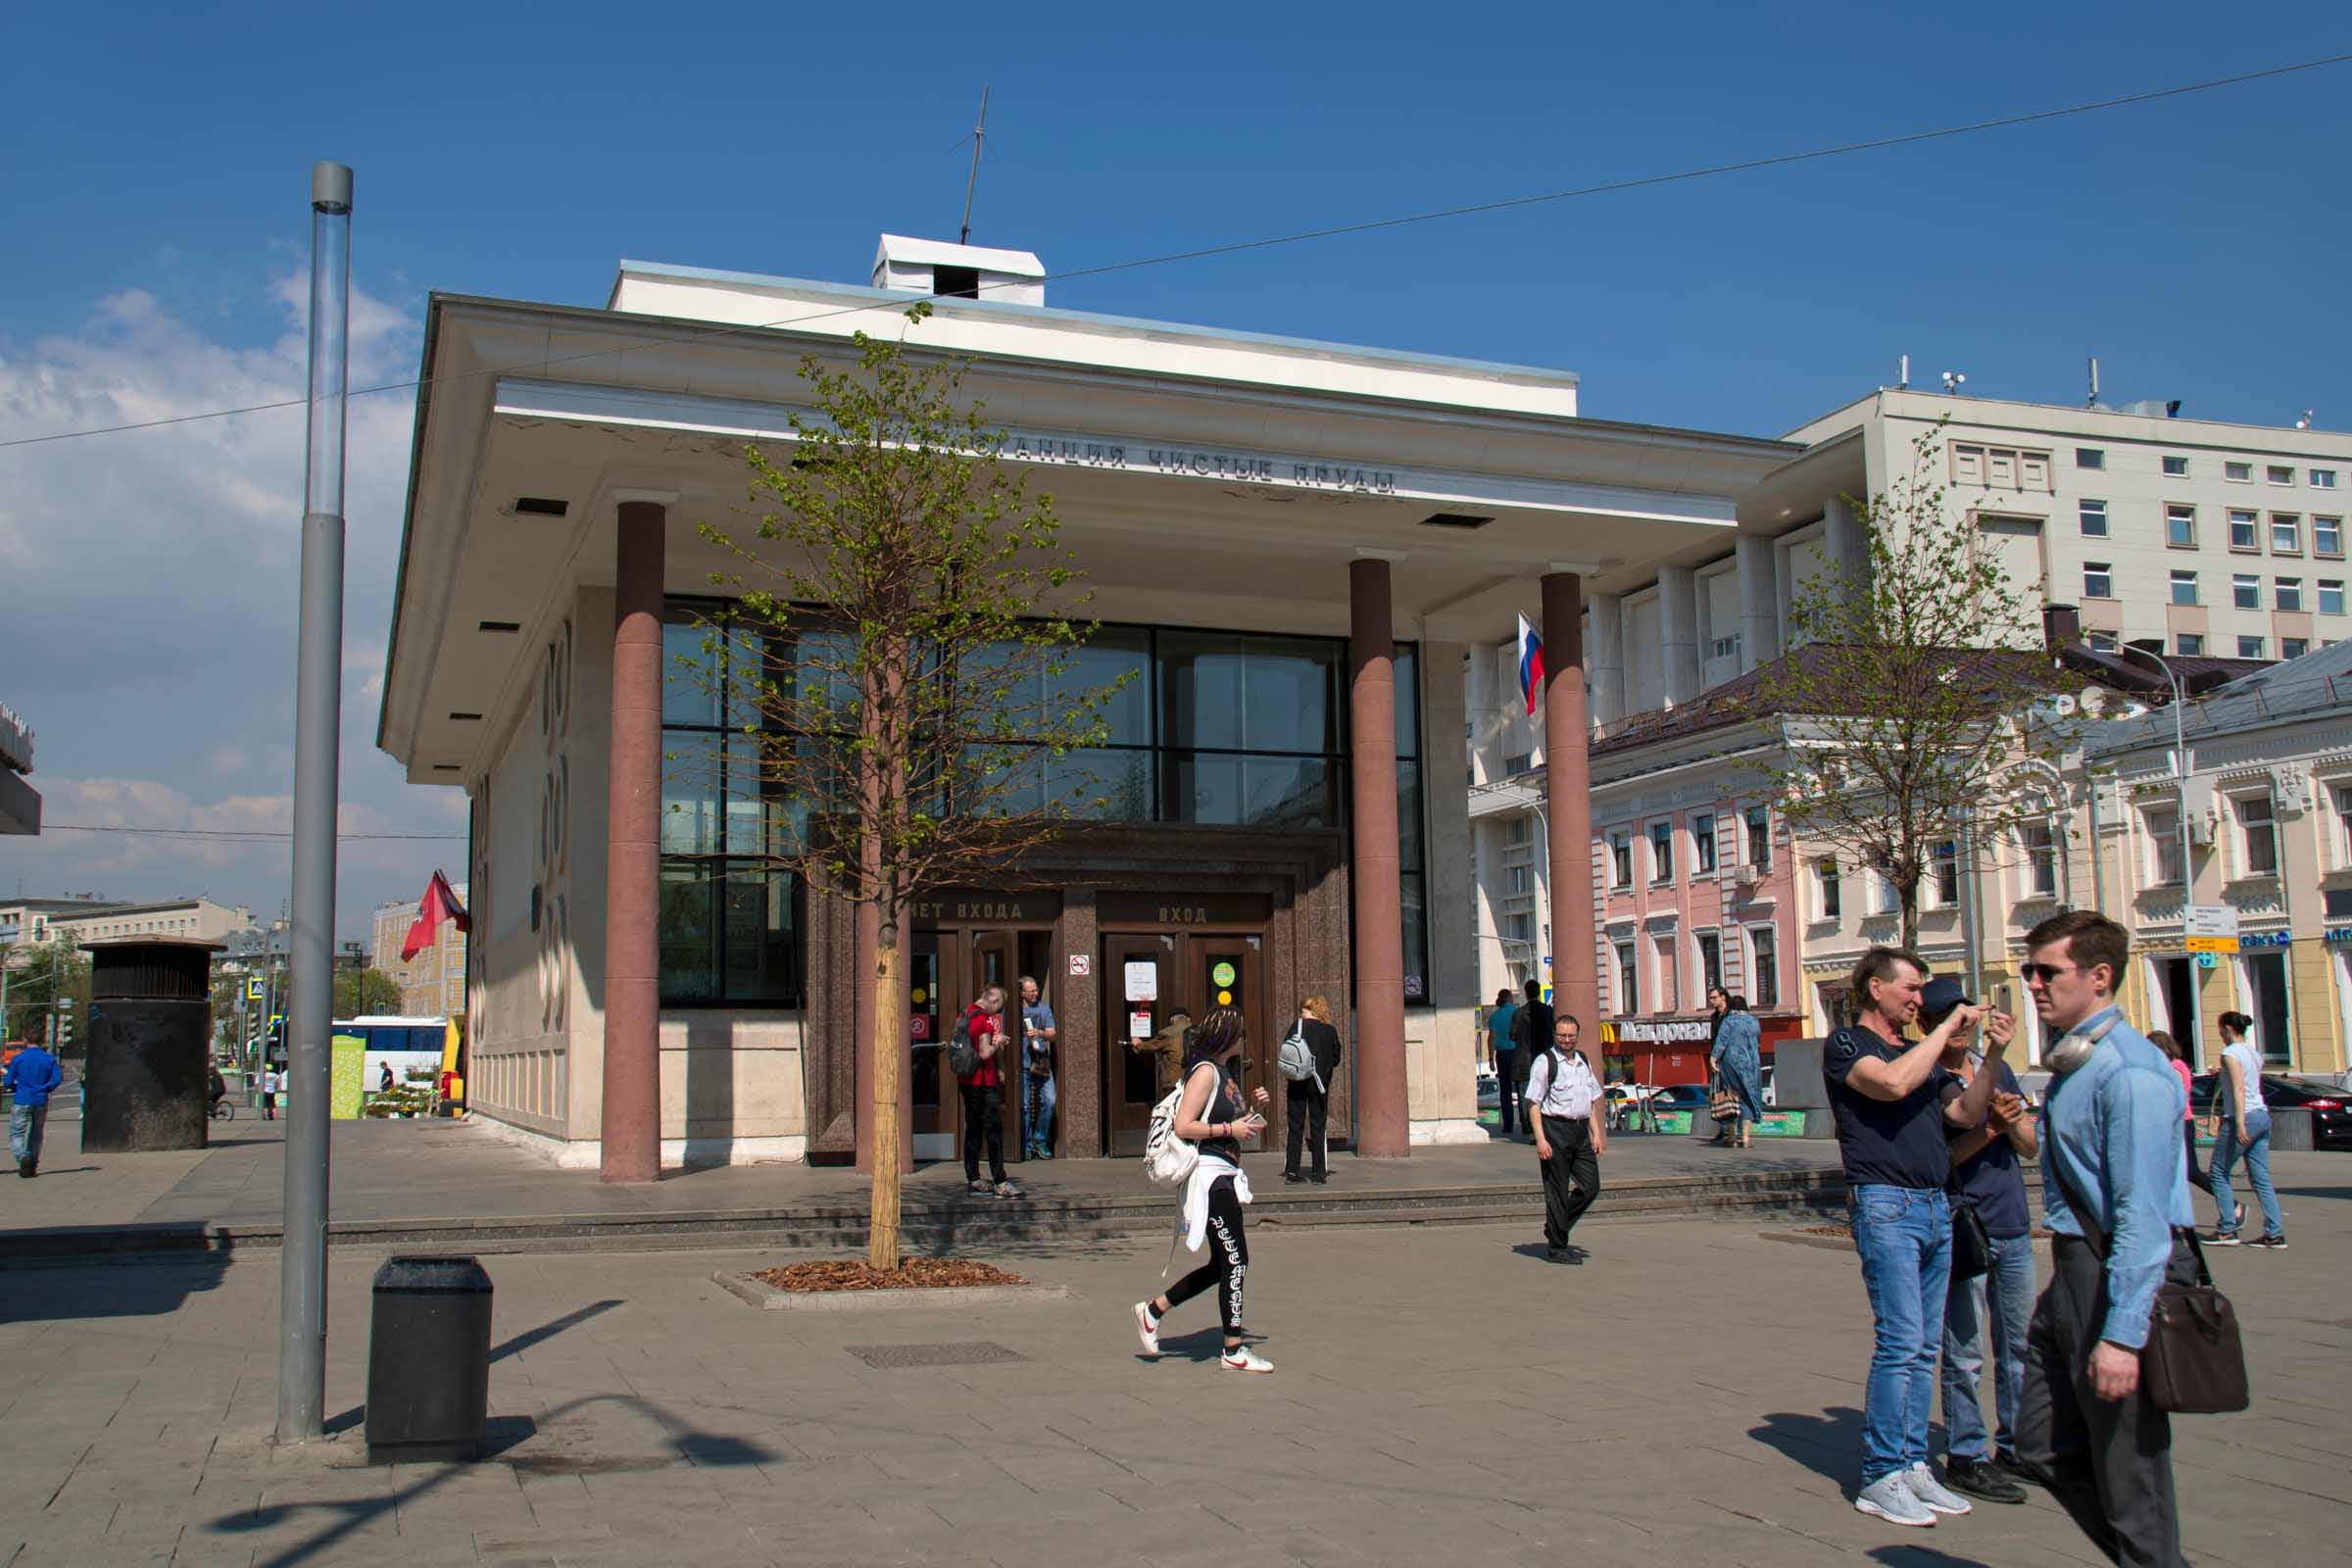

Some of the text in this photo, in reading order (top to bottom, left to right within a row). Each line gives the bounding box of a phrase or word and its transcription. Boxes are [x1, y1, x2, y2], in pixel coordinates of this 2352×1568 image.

[1149, 449, 1273, 483] ЧИСТЫЕ
[1294, 463, 1396, 495] ПРУДЫ
[957, 902, 1022, 919] ВХОДА
[1159, 907, 1206, 925] ВХОД
[1620, 1021, 1712, 1045] Макдонал
